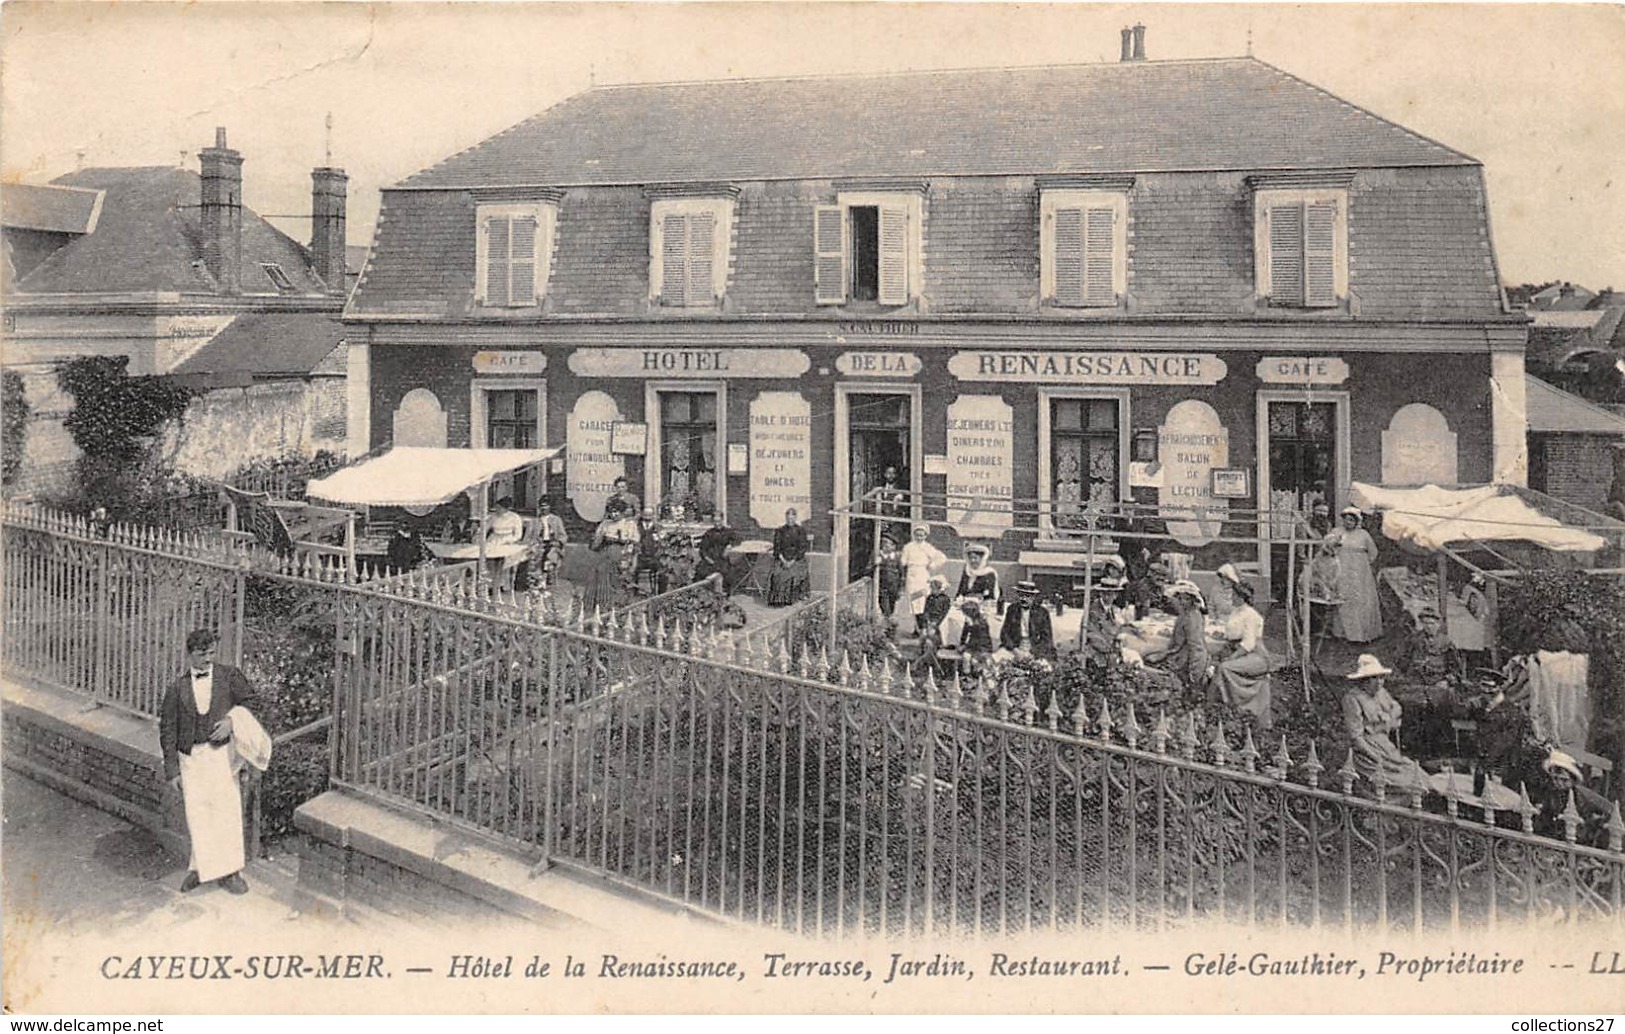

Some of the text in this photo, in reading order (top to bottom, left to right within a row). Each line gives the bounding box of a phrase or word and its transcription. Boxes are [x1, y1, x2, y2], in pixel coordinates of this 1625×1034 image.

[643, 352, 729, 370] HOTEL
[851, 355, 907, 371] DE LA
[978, 354, 1201, 378] RENAISSANCE
[1279, 361, 1327, 375] CAFÉ
[1177, 452, 1210, 464] SALON
[1171, 485, 1211, 497] LECTUR
